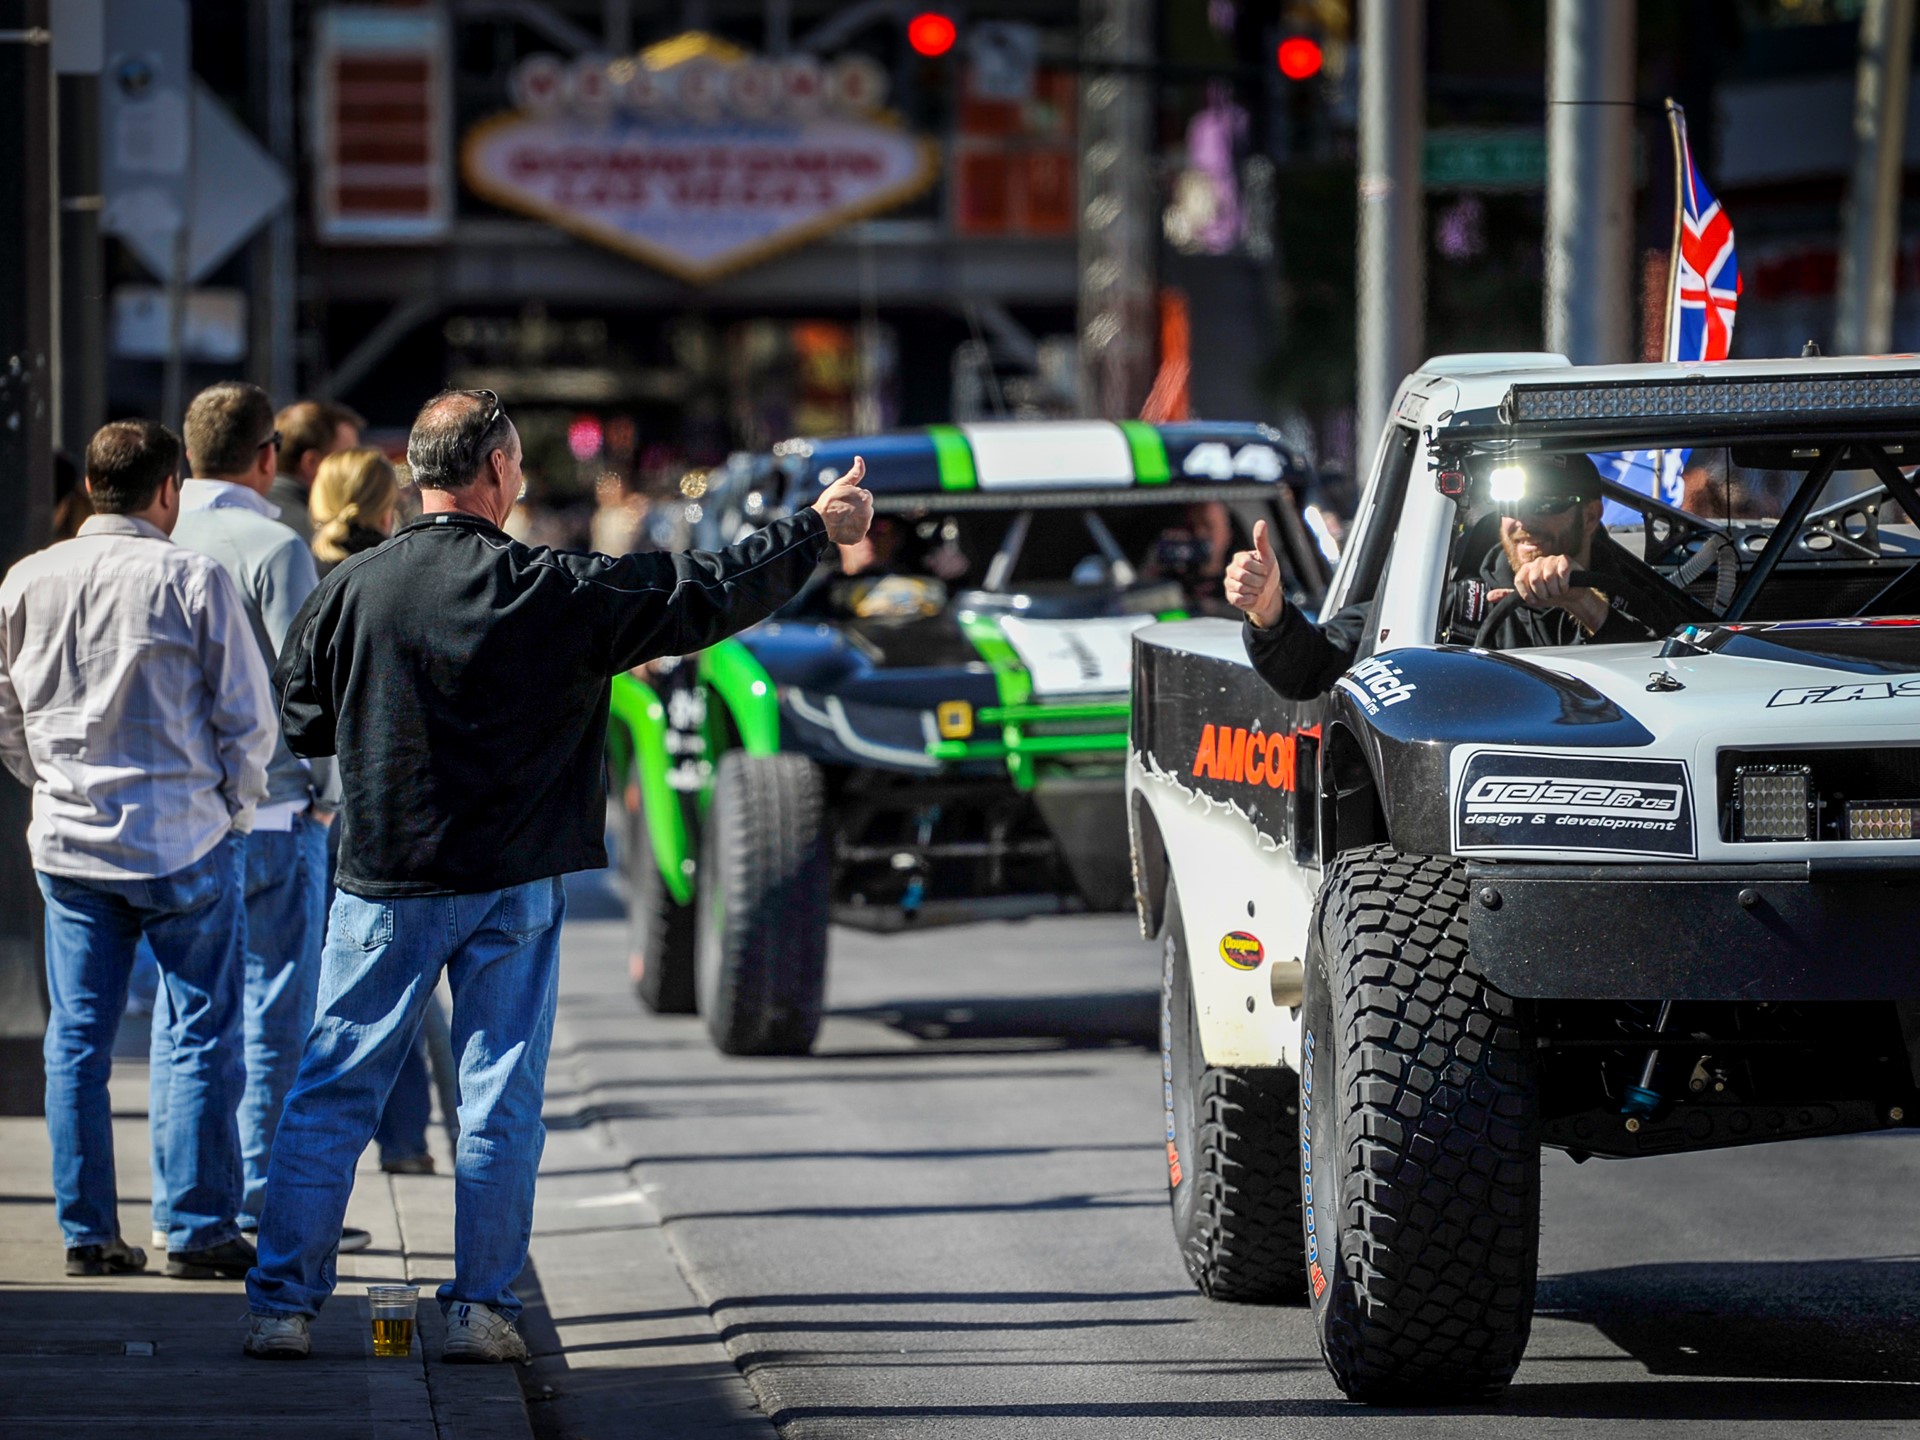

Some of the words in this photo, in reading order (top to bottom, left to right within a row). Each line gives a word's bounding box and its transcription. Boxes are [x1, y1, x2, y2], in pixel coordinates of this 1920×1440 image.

[1183, 442, 1284, 481] 44
[1613, 793, 1675, 810] Bros
[1464, 813, 1523, 826] design
[1531, 813, 1547, 825] &
[1555, 815, 1676, 831] development
[1303, 1029, 1327, 1300] BFGoodrich
